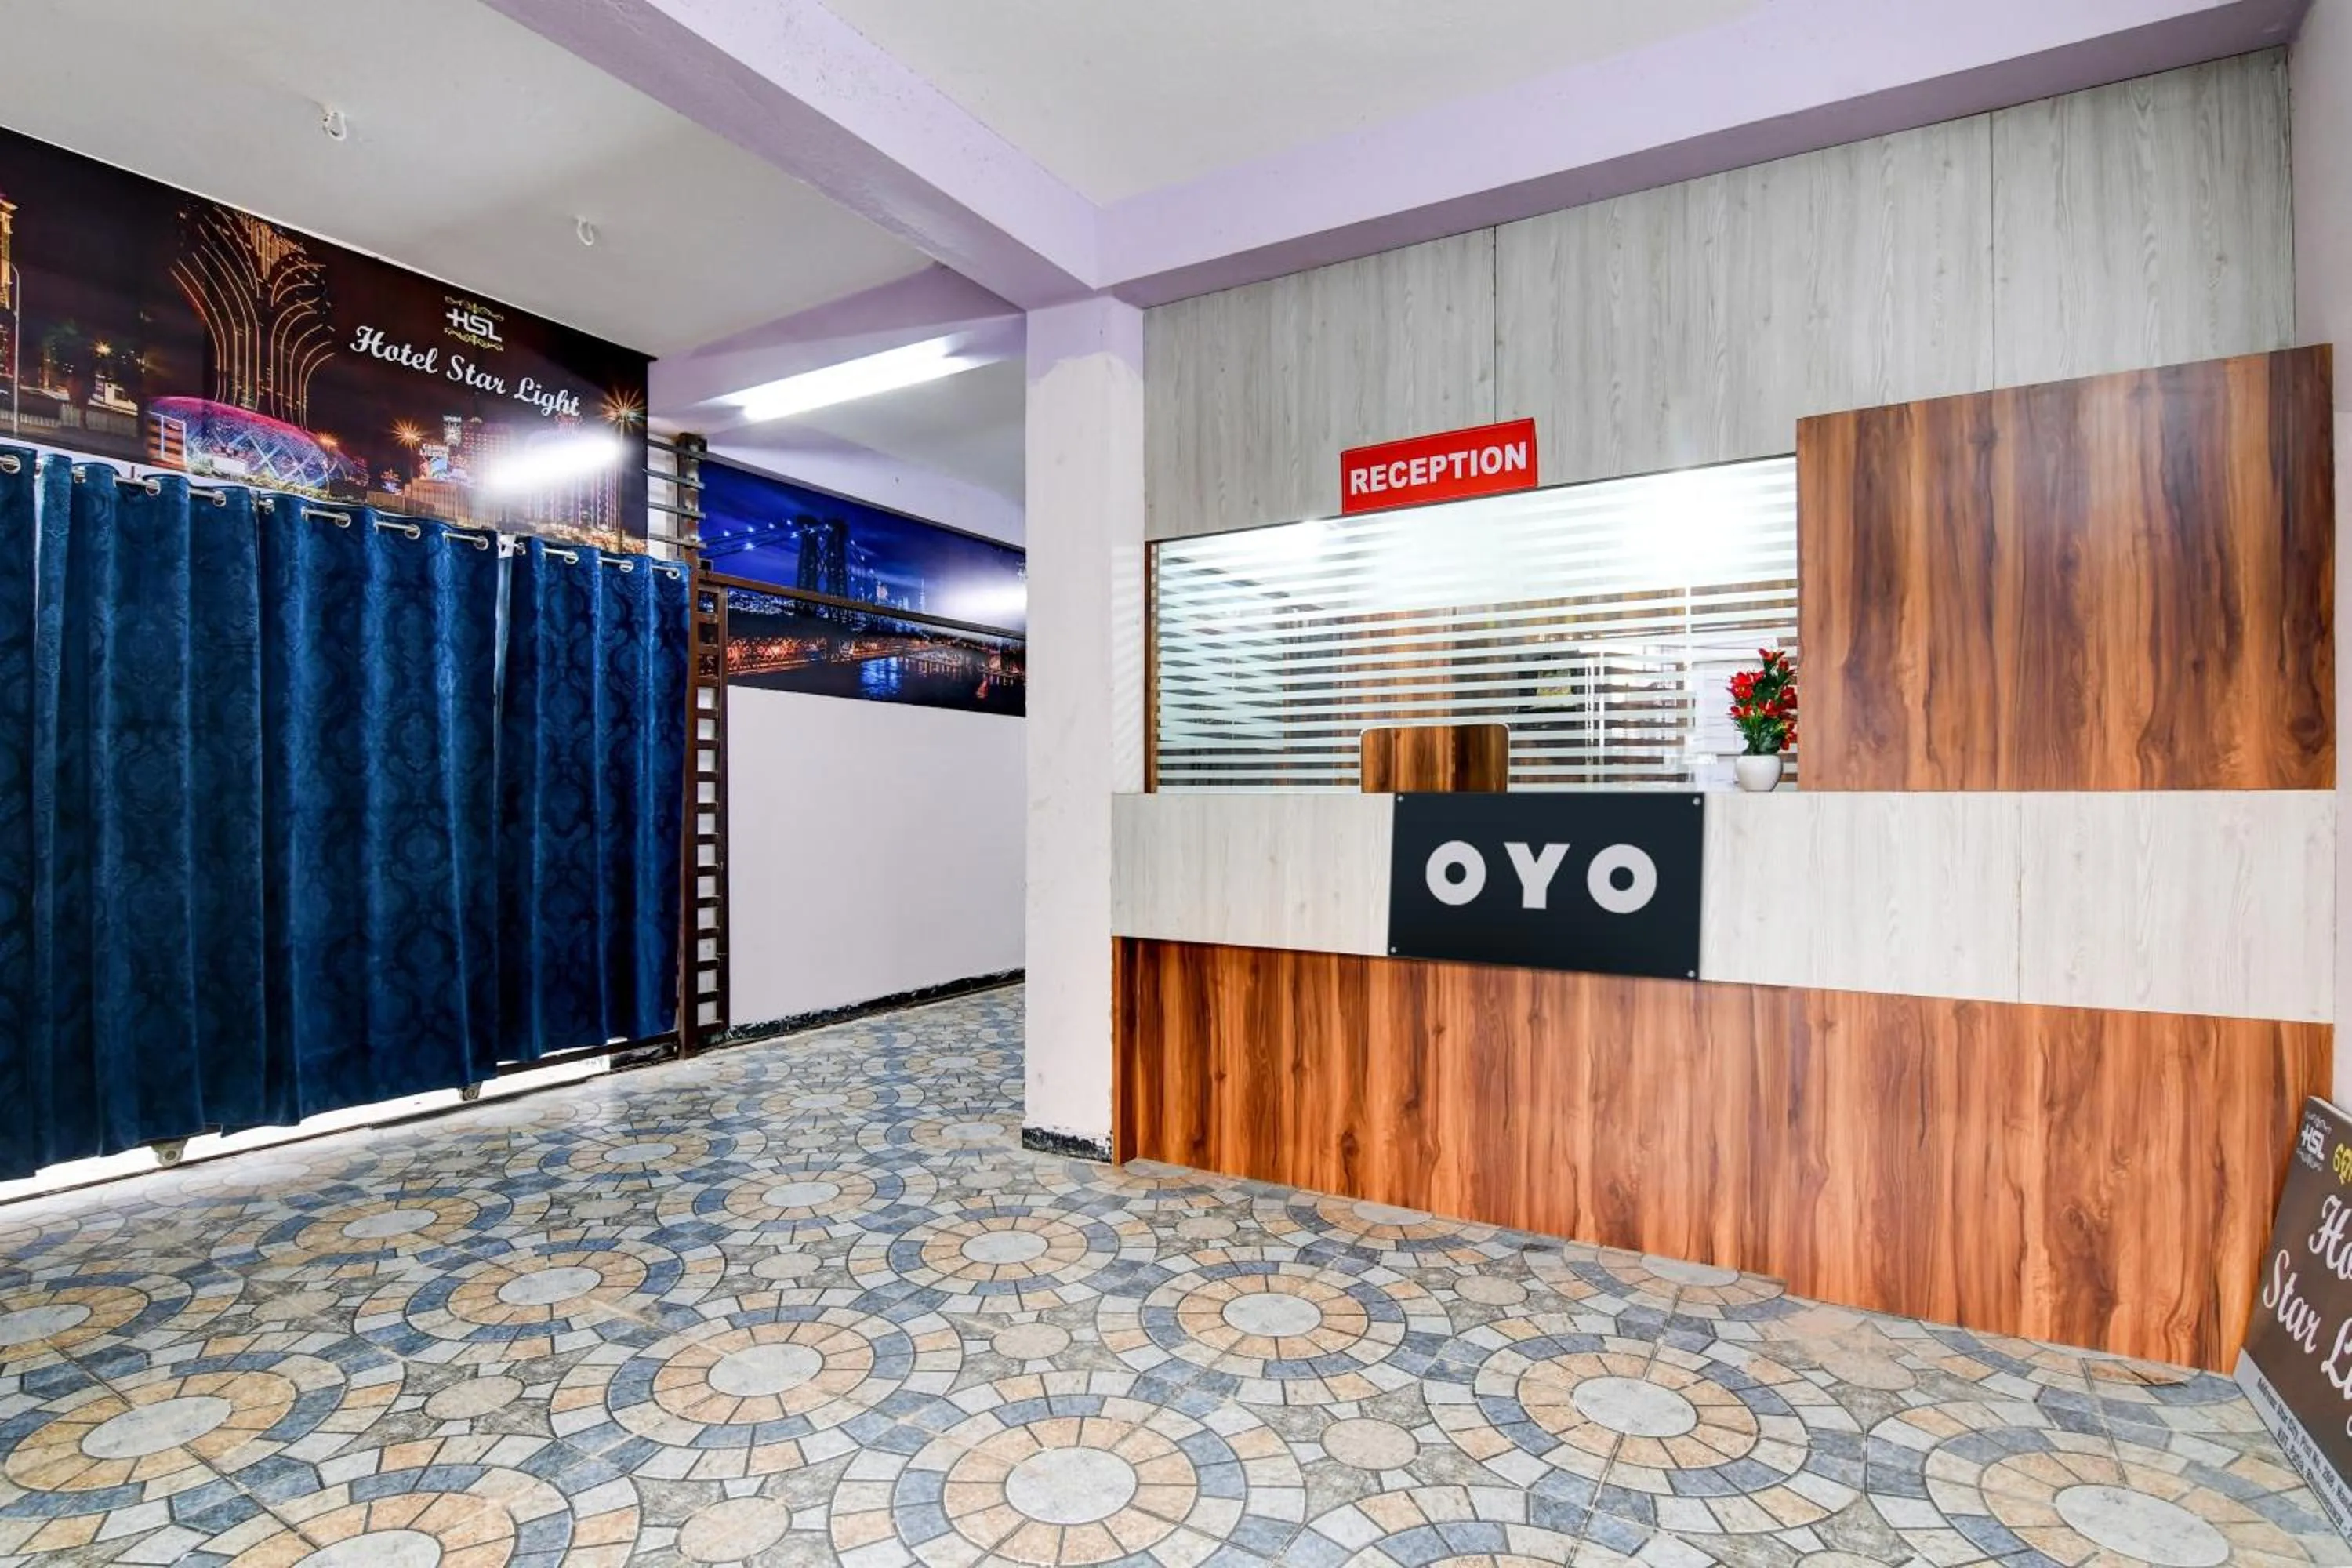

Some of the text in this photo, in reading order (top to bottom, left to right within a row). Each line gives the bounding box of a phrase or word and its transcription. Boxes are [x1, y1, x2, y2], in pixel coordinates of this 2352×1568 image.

[445, 308, 503, 343] HSL
[350, 325, 581, 416] Hotel Star Light
[1350, 441, 1527, 495] RECEPTION
[1425, 840, 1658, 914] OYO
[2262, 1248, 2321, 1355] Star
